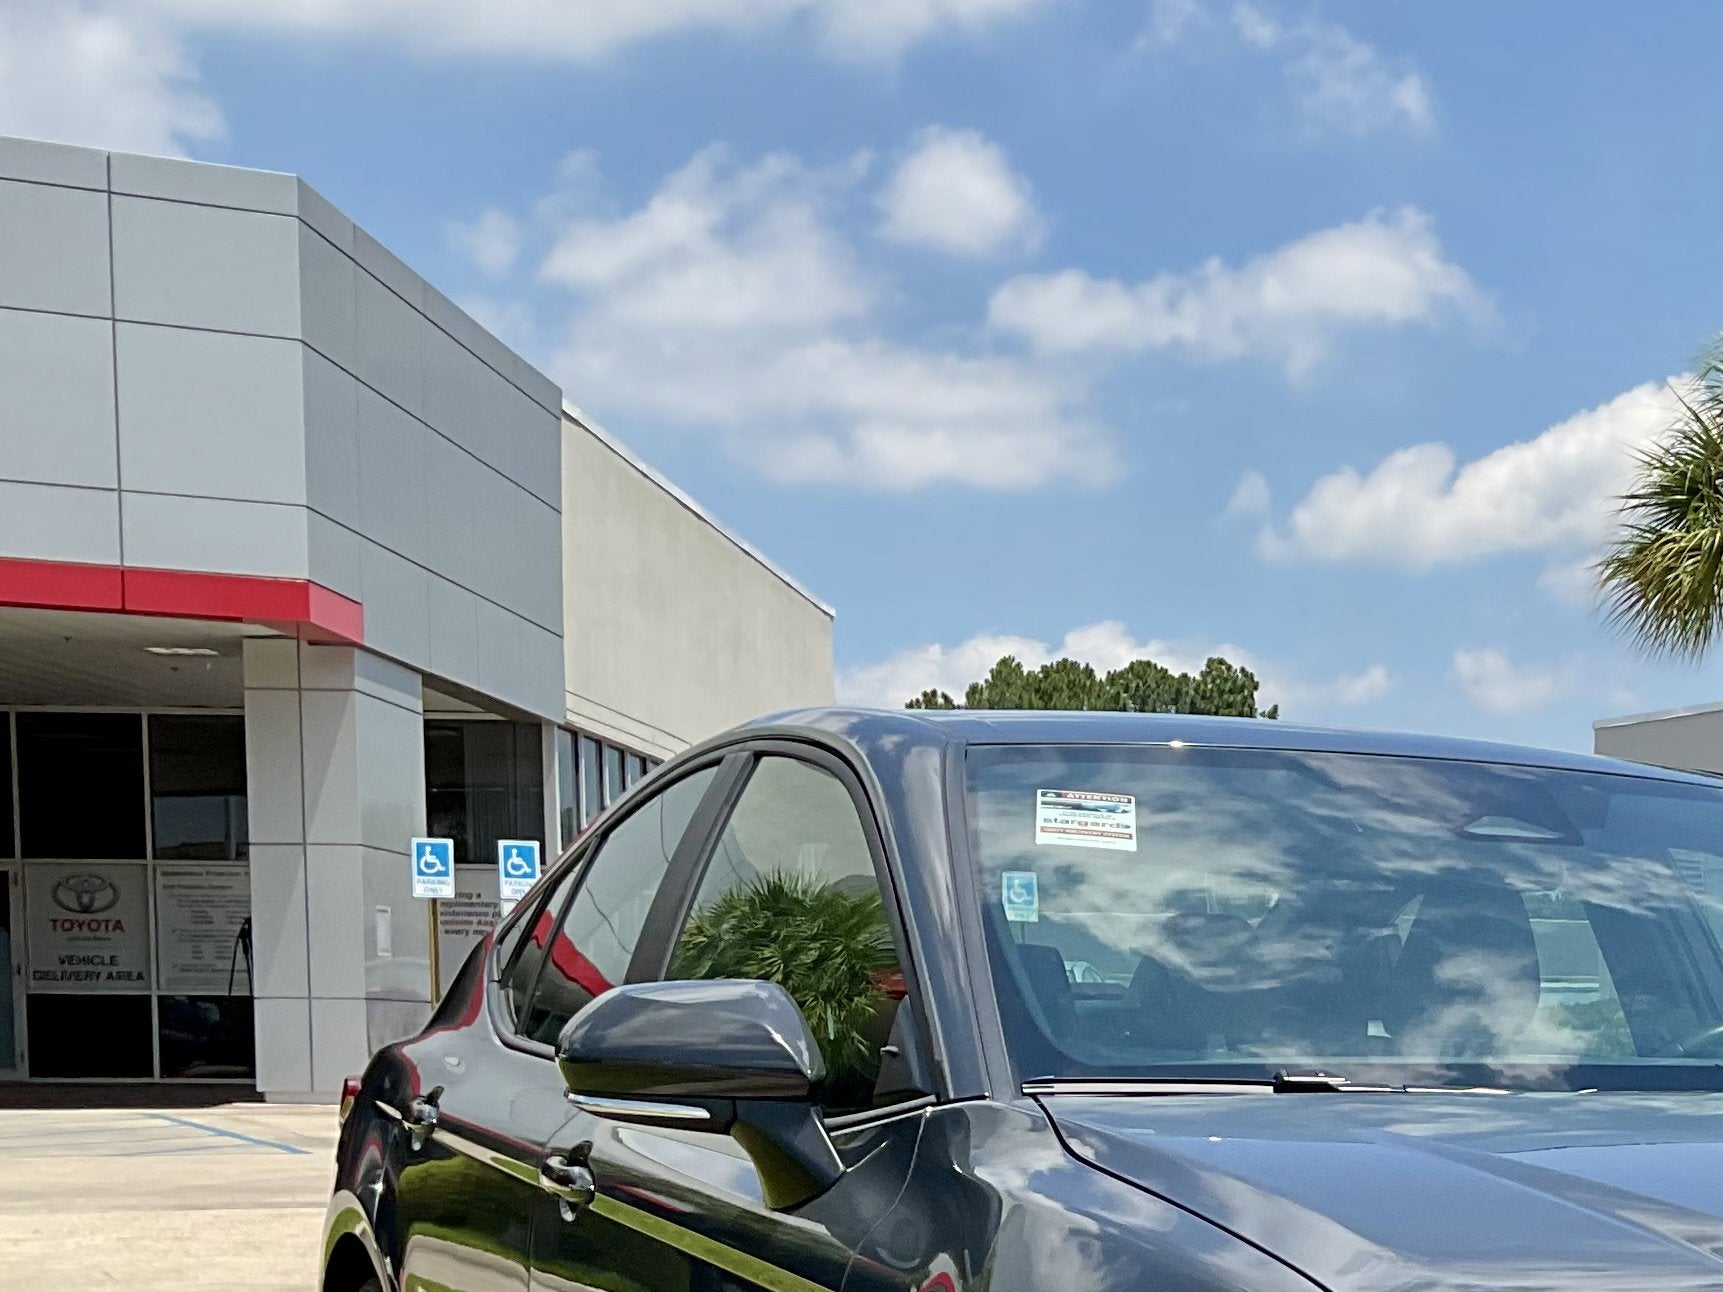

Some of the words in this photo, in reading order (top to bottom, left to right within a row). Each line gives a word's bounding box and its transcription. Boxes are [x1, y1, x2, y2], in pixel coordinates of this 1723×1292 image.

[1066, 792, 1129, 803] ATTENTION
[417, 878, 450, 886] PARKING
[50, 919, 125, 932] TOYOTA
[58, 955, 119, 966] VEHICLE
[33, 971, 102, 981] DELIVERY
[106, 971, 145, 981] AREA
